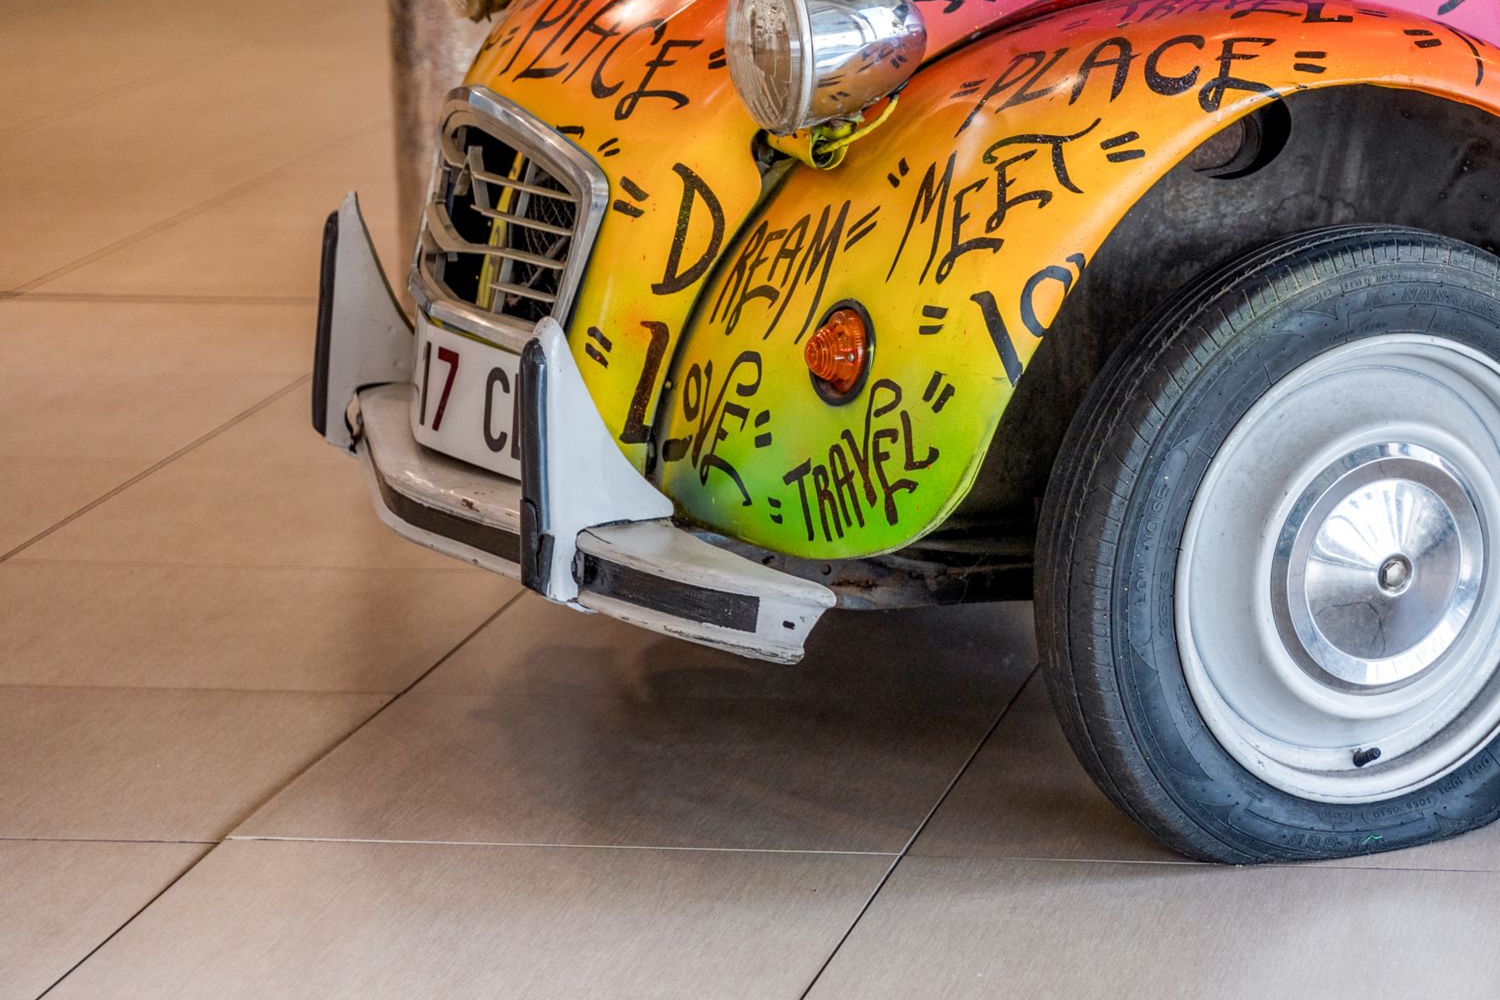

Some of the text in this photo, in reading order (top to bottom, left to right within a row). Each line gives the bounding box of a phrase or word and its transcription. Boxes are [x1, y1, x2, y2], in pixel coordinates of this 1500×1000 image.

[955, 34, 1285, 139] PLACE
[886, 117, 1102, 285] MEET
[782, 378, 939, 544] TRAVEL
